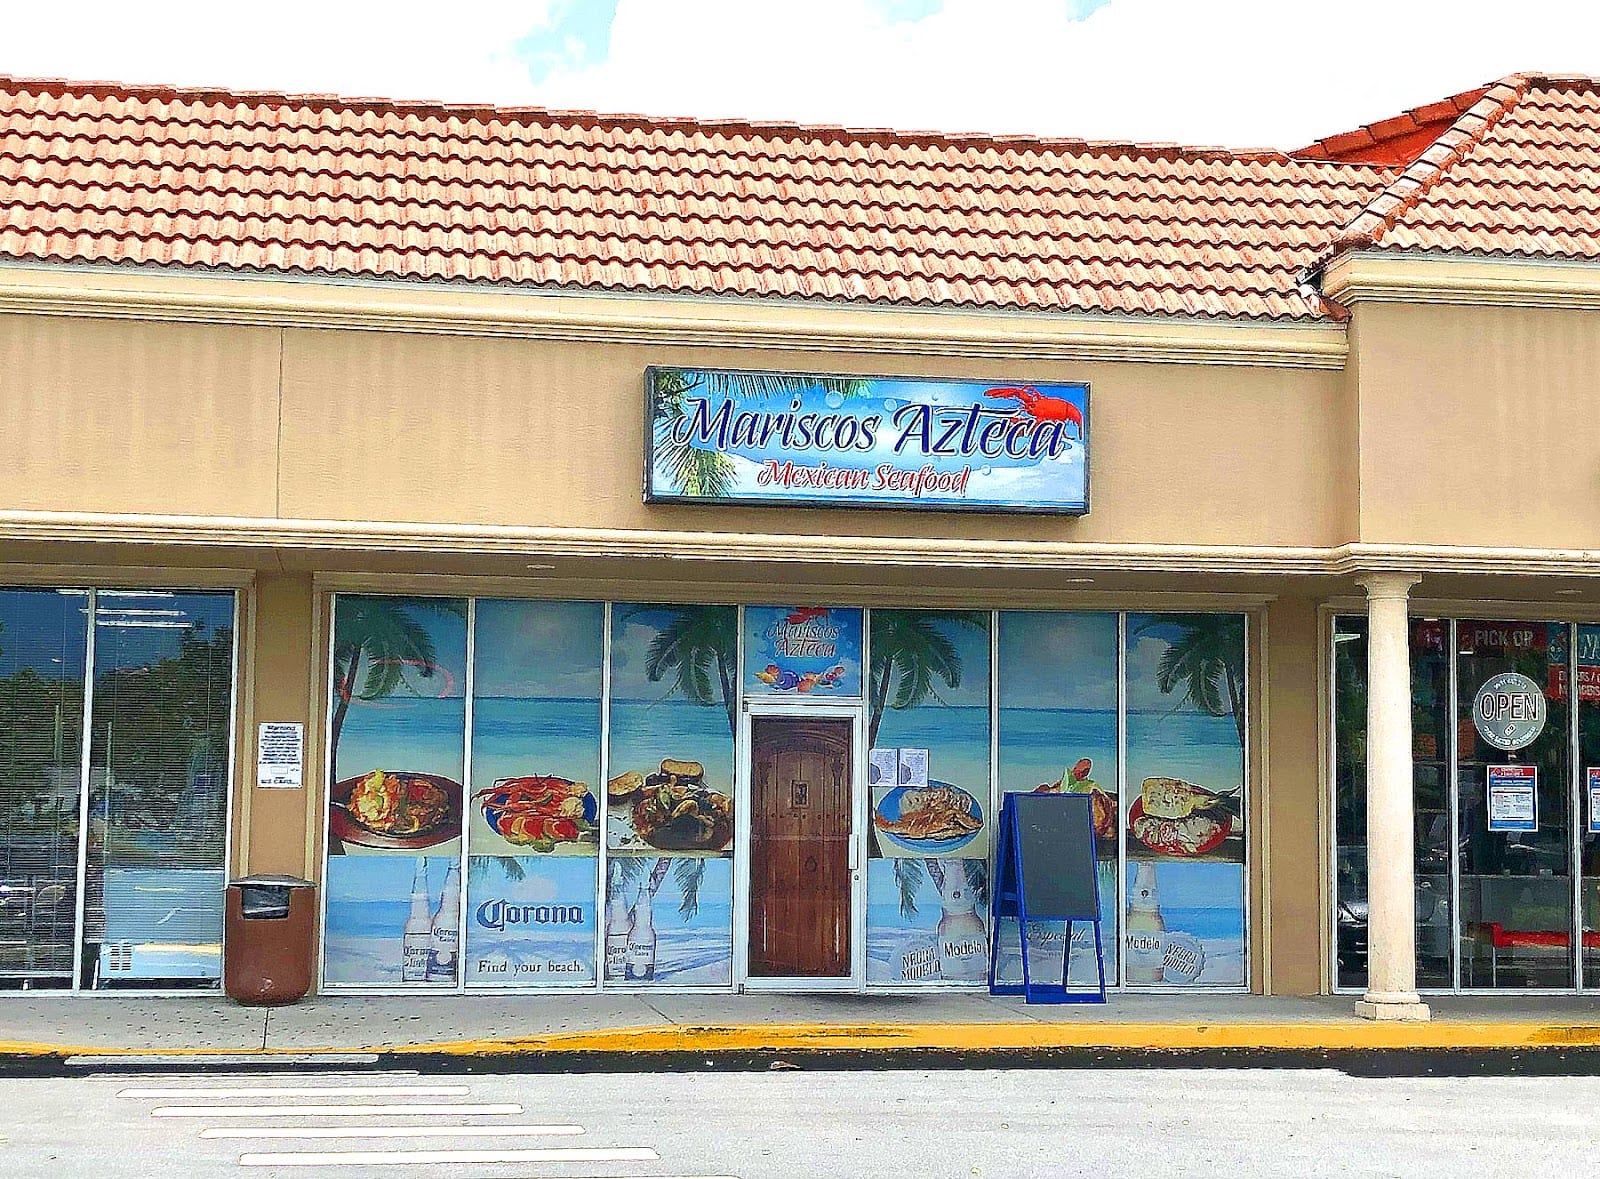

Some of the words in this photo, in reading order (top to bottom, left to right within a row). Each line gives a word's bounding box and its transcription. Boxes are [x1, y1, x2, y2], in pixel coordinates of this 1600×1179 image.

[672, 397, 881, 450] Mariscos
[893, 403, 1066, 460] Azteca
[757, 459, 869, 489] Mexican
[872, 463, 970, 498] Seafood
[767, 621, 840, 639] Mariscos
[1474, 629, 1508, 647] PICK
[774, 638, 836, 657] Azteca
[1480, 692, 1539, 721] OPEN
[476, 898, 585, 932] Corona
[944, 940, 982, 958] Modelo
[1126, 936, 1160, 950] Modelo
[478, 960, 507, 973] Find
[514, 963, 541, 977] your
[548, 960, 584, 973] beach.
